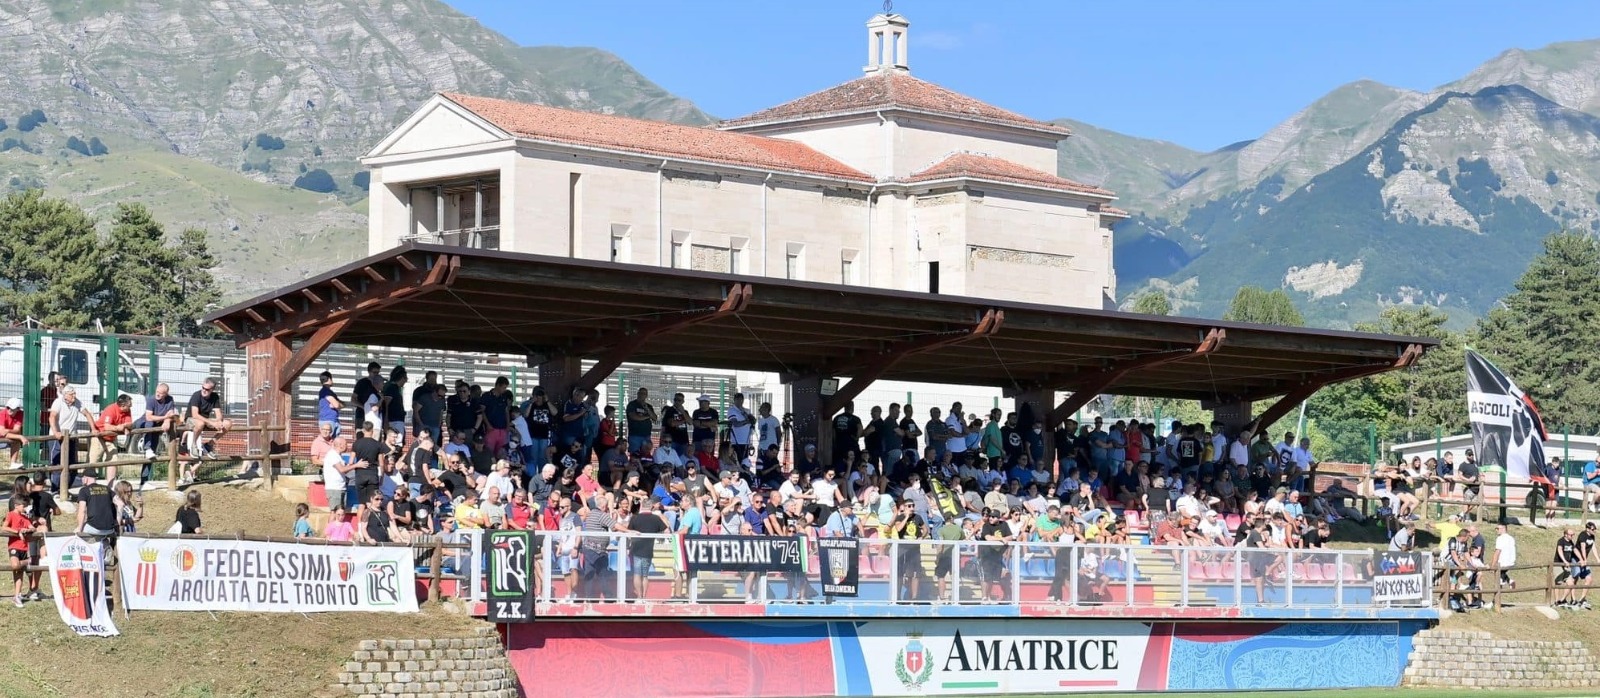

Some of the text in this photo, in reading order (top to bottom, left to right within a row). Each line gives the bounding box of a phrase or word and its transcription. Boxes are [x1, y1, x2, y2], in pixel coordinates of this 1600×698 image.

[1471, 401, 1510, 418] ASCOLI
[684, 539, 772, 564] VETERANI
[204, 549, 331, 581] FEDELISSIMI
[169, 579, 359, 606] ARQUATA DEL TRONTO
[496, 601, 527, 619] Z.K.
[942, 628, 1119, 671] AMATRICE
